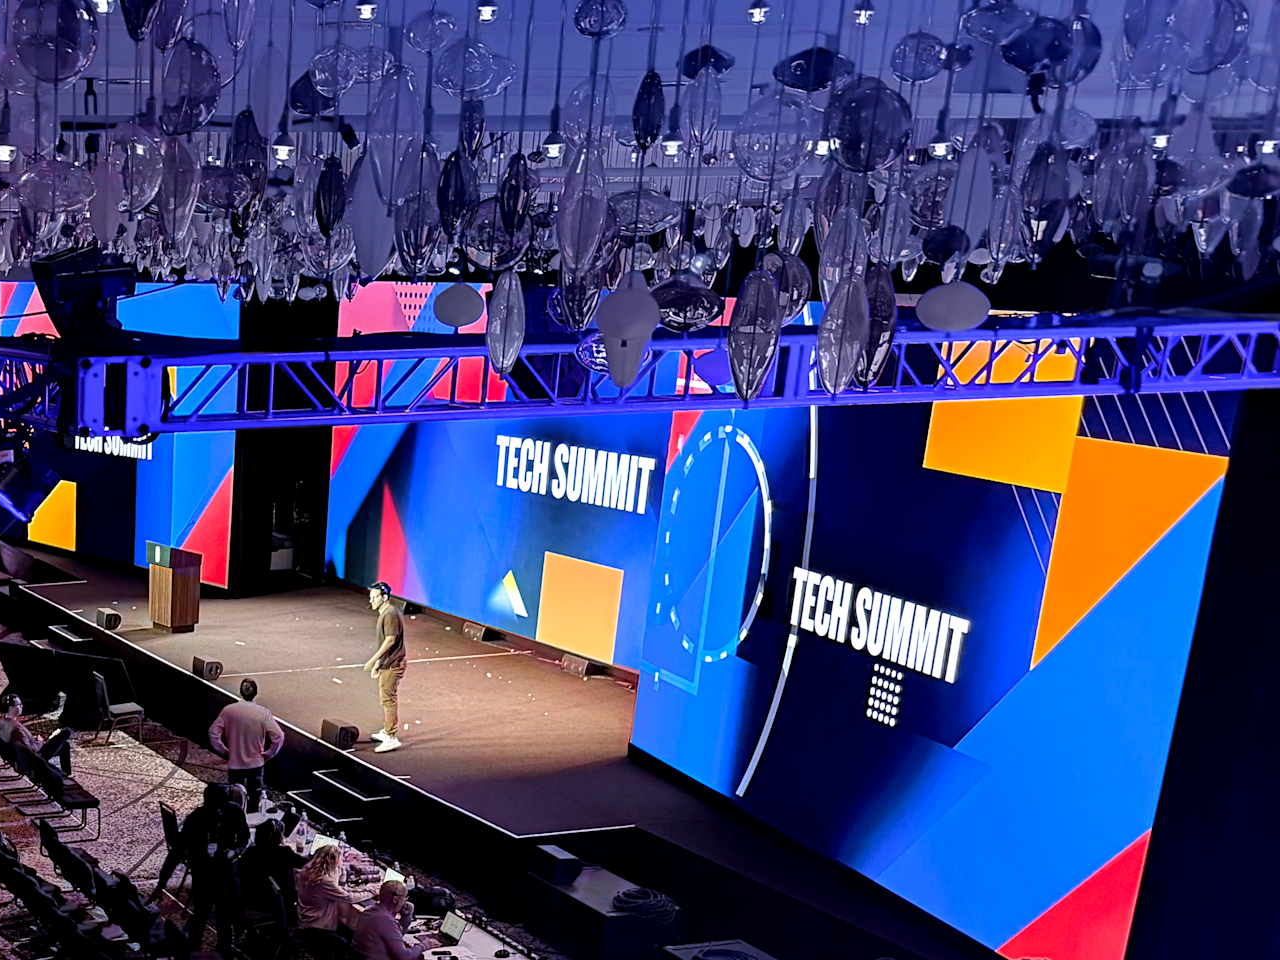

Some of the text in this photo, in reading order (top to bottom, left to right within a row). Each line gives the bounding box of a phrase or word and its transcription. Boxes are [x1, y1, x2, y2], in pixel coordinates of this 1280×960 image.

[496, 435, 656, 515] TECH SUMMIT
[790, 566, 970, 684] TECH SUMMIT
